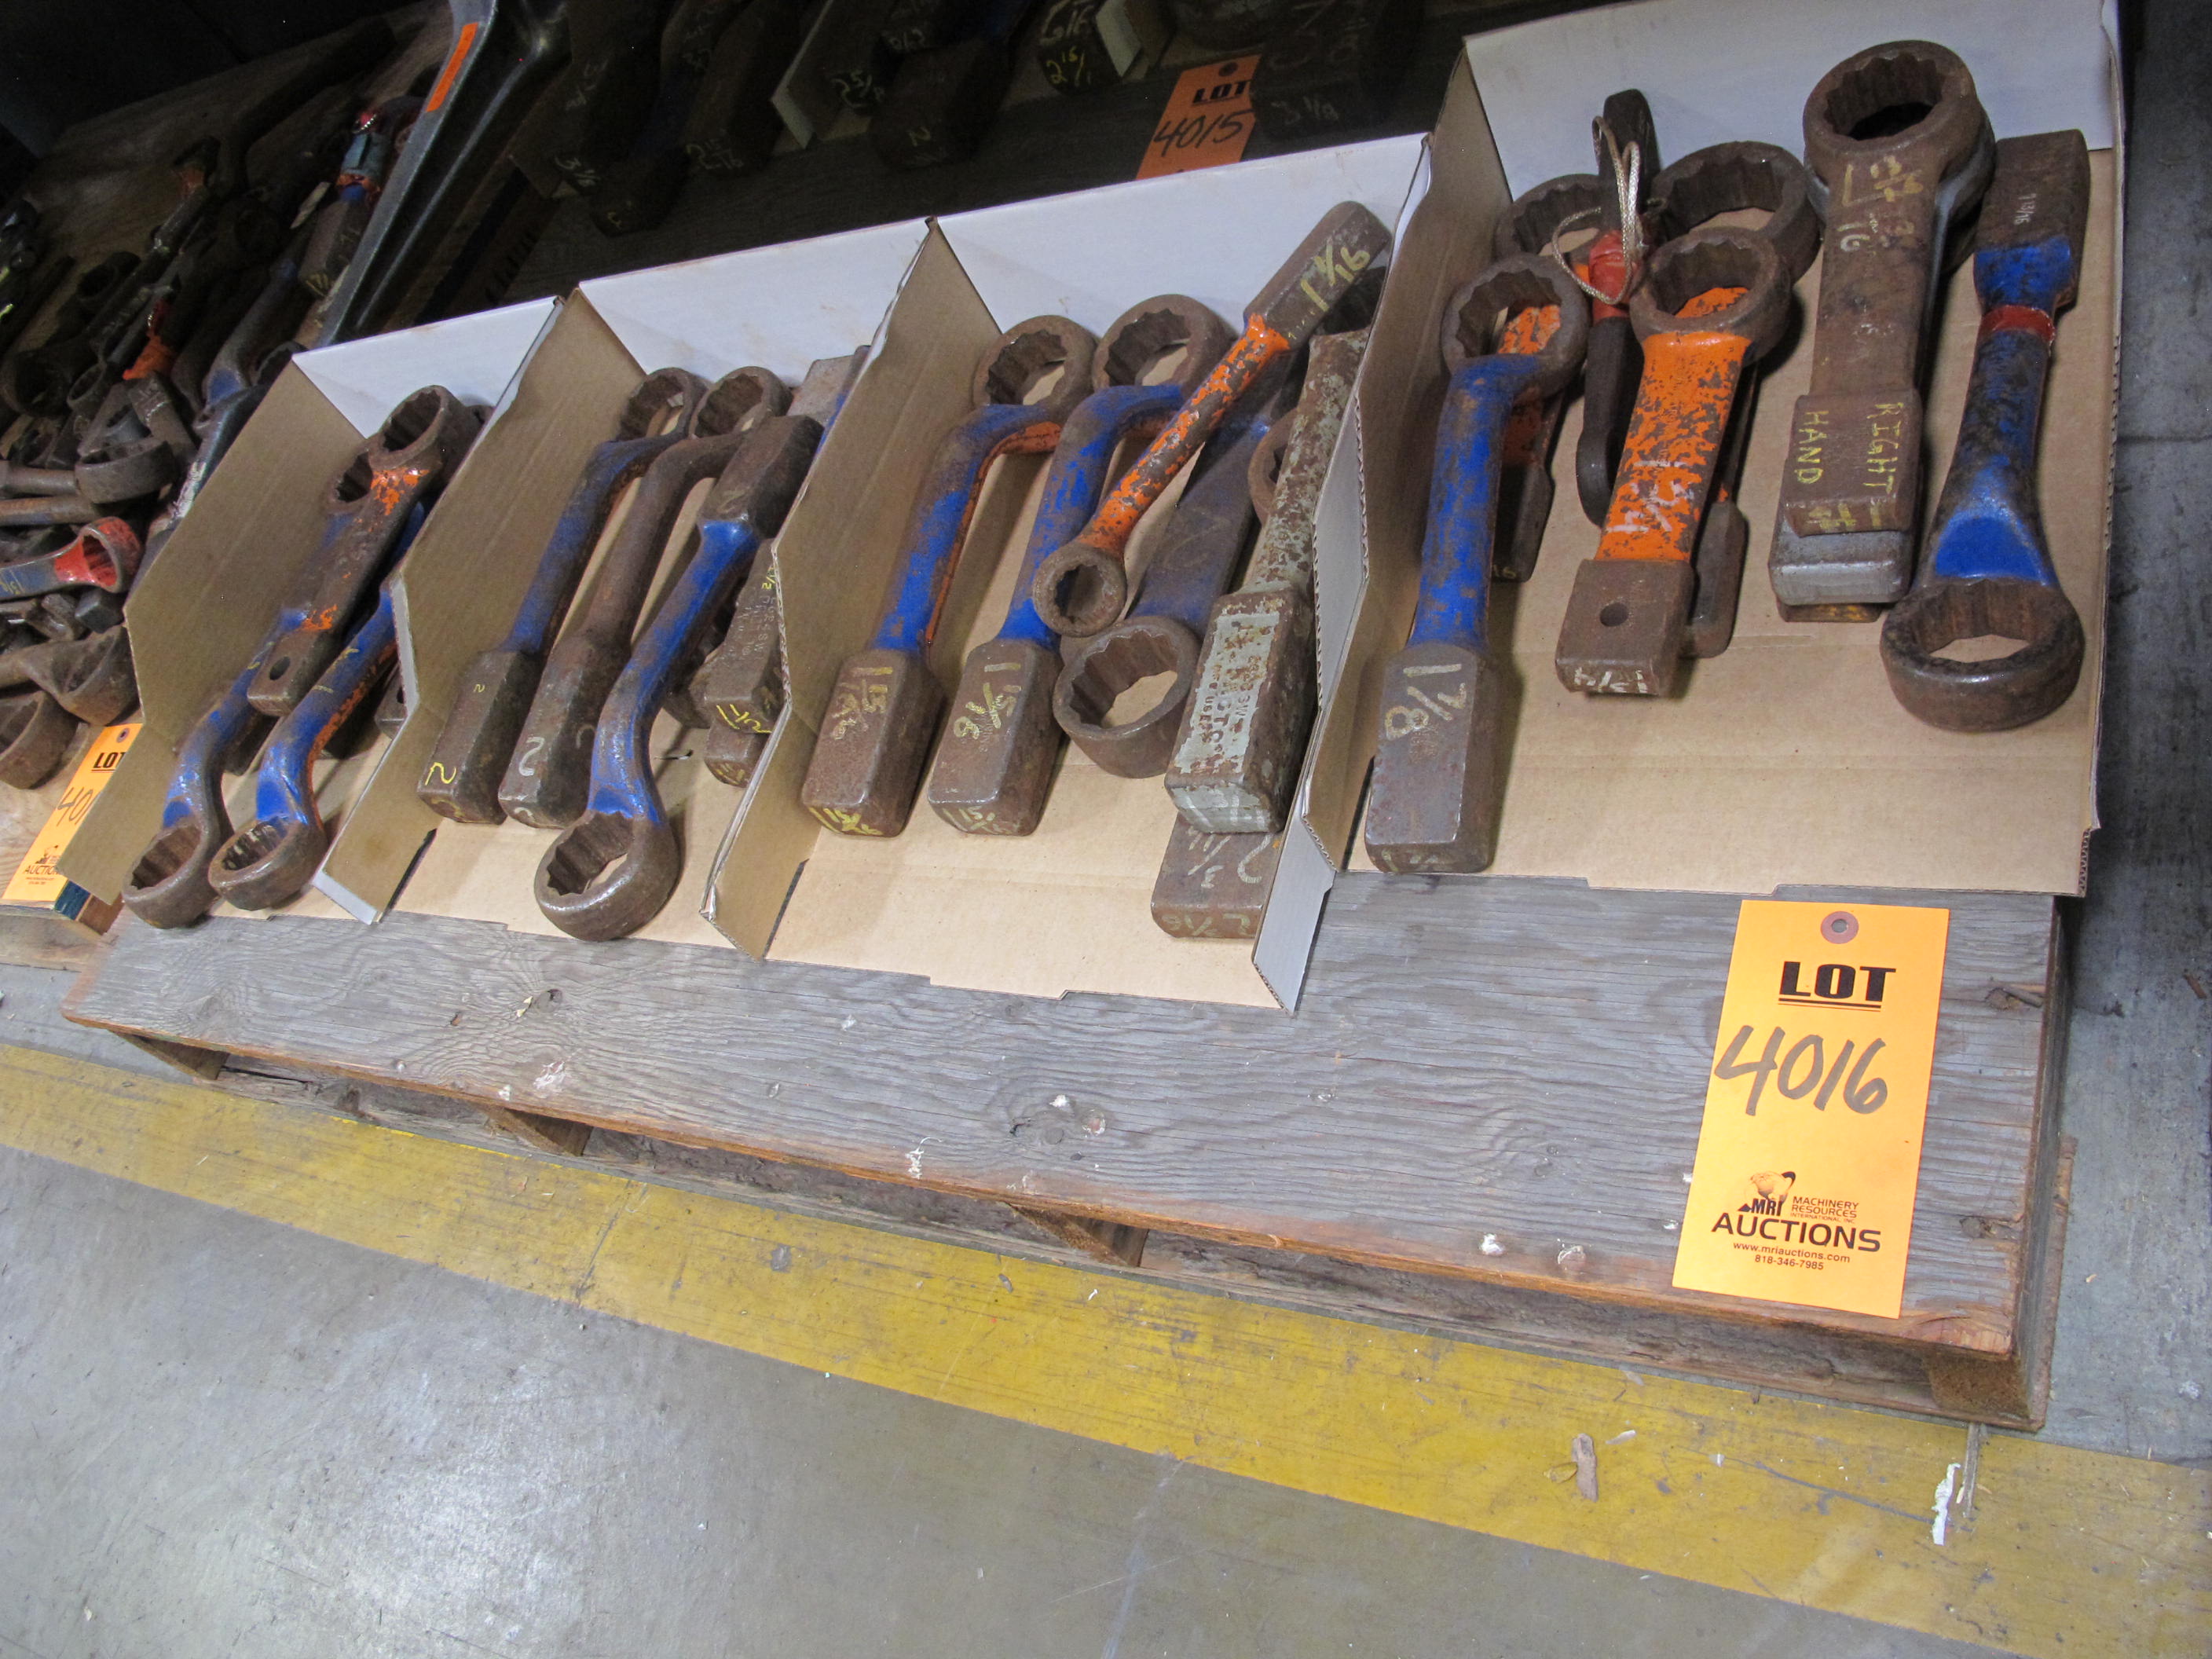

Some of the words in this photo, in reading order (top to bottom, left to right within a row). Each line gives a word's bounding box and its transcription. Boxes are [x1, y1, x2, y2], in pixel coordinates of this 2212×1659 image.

[1192, 81, 1251, 103] LOT
[1154, 108, 1255, 157] 4015
[1793, 410, 1829, 485] HAND
[1862, 401, 1904, 494] RIGHT
[518, 736, 546, 776] 2
[425, 761, 457, 786] 2
[1778, 961, 1897, 1002] LOT
[1713, 1024, 1888, 1116] 4016
[1751, 1198, 1783, 1217] MRI
[1791, 1204, 1858, 1218] RESOURCES
[1793, 1196, 1859, 1210] MACHINERY
[1789, 1212, 1841, 1222] INTERNATIONAL
[1710, 1212, 1882, 1253] AUCTIONS
[1732, 1241, 1851, 1263] www.mriauctions.com
[1754, 1254, 1825, 1270] 818-346-7985
